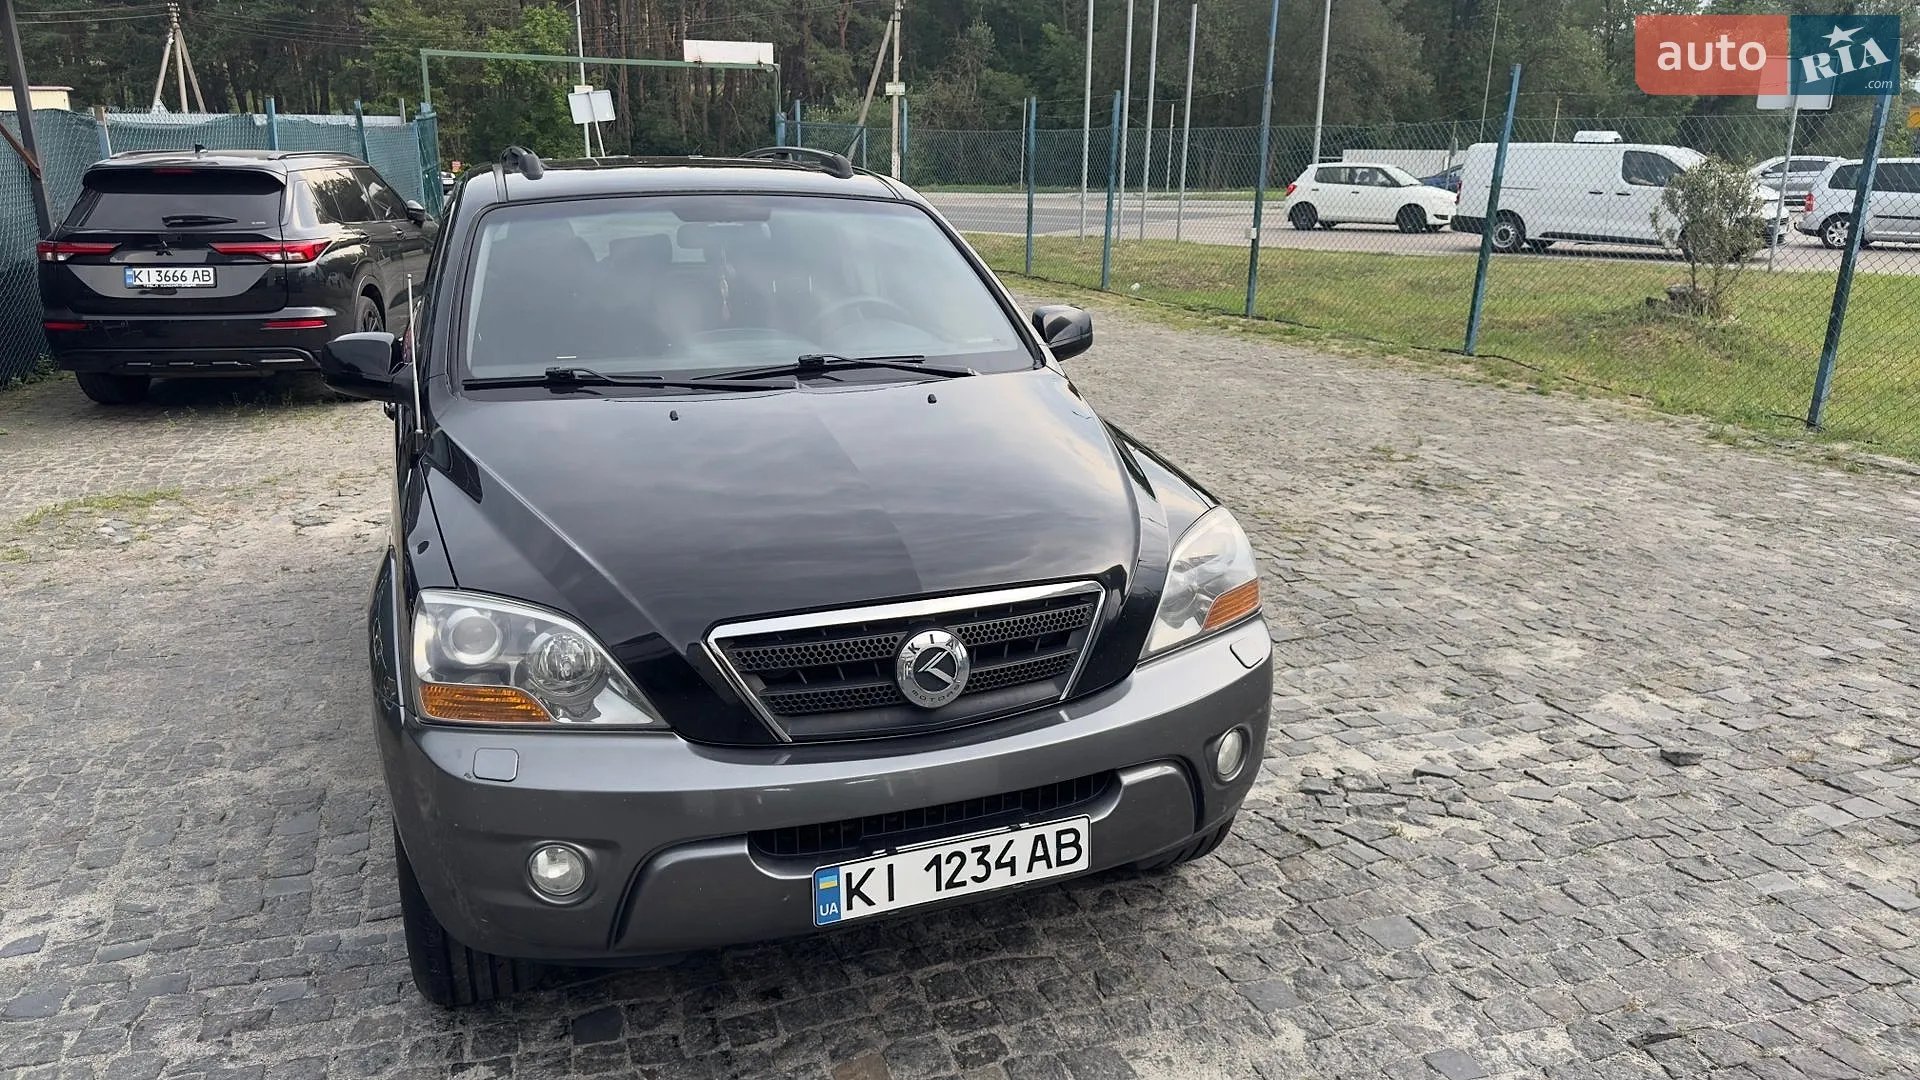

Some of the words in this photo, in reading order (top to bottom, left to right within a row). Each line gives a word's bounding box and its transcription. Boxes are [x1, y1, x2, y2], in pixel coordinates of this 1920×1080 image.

[133, 269, 151, 282] KI
[155, 270, 188, 282] 3666
[192, 269, 212, 282] AB
[908, 633, 954, 655] KIA
[845, 863, 895, 911] KI
[924, 839, 1017, 892] 1234
[1026, 827, 1083, 873] AB
[819, 902, 838, 917] UA
